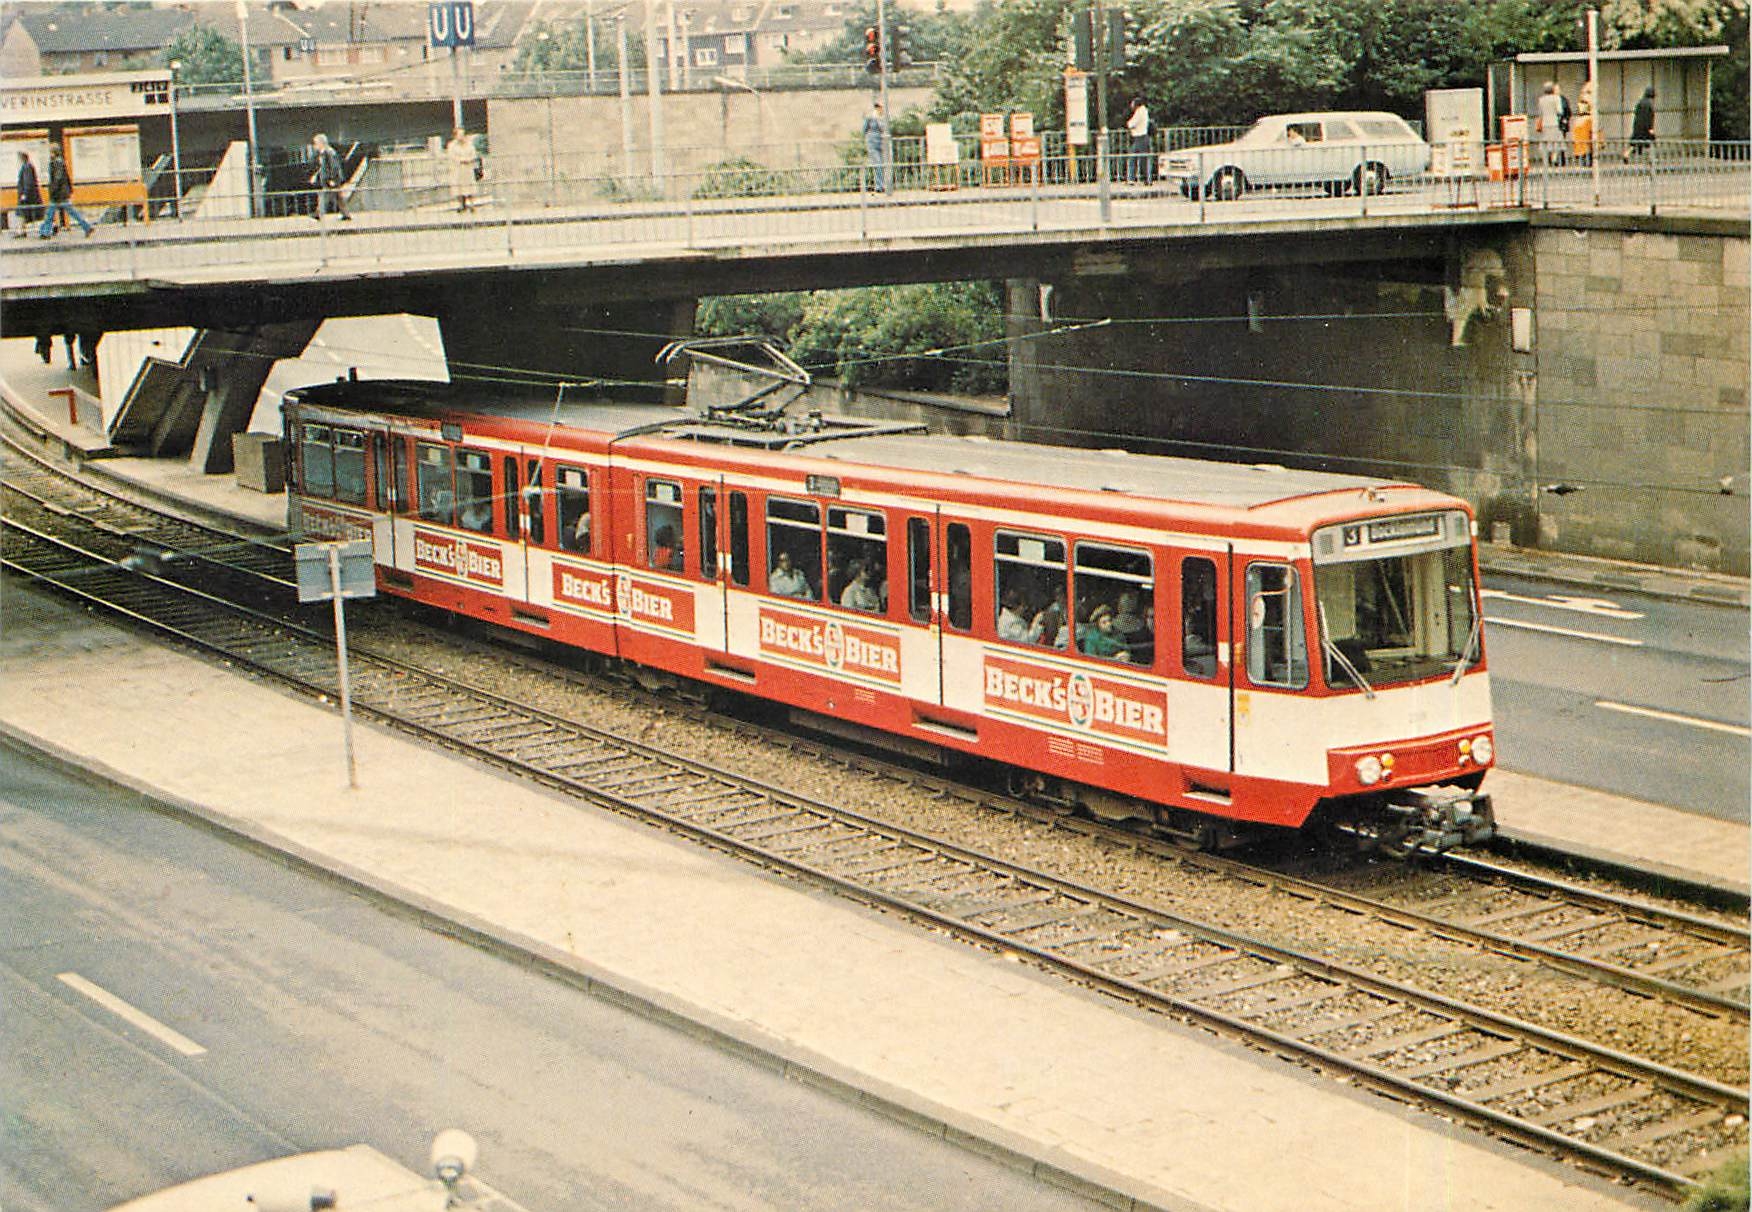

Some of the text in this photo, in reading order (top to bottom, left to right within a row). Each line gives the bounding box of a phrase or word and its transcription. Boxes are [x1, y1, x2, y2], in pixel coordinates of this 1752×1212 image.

[1346, 527, 1357, 545] 3
[469, 551, 501, 579] BIER
[632, 587, 673, 620] BIER
[845, 634, 898, 673] BIER
[1094, 688, 1165, 735] BIER
